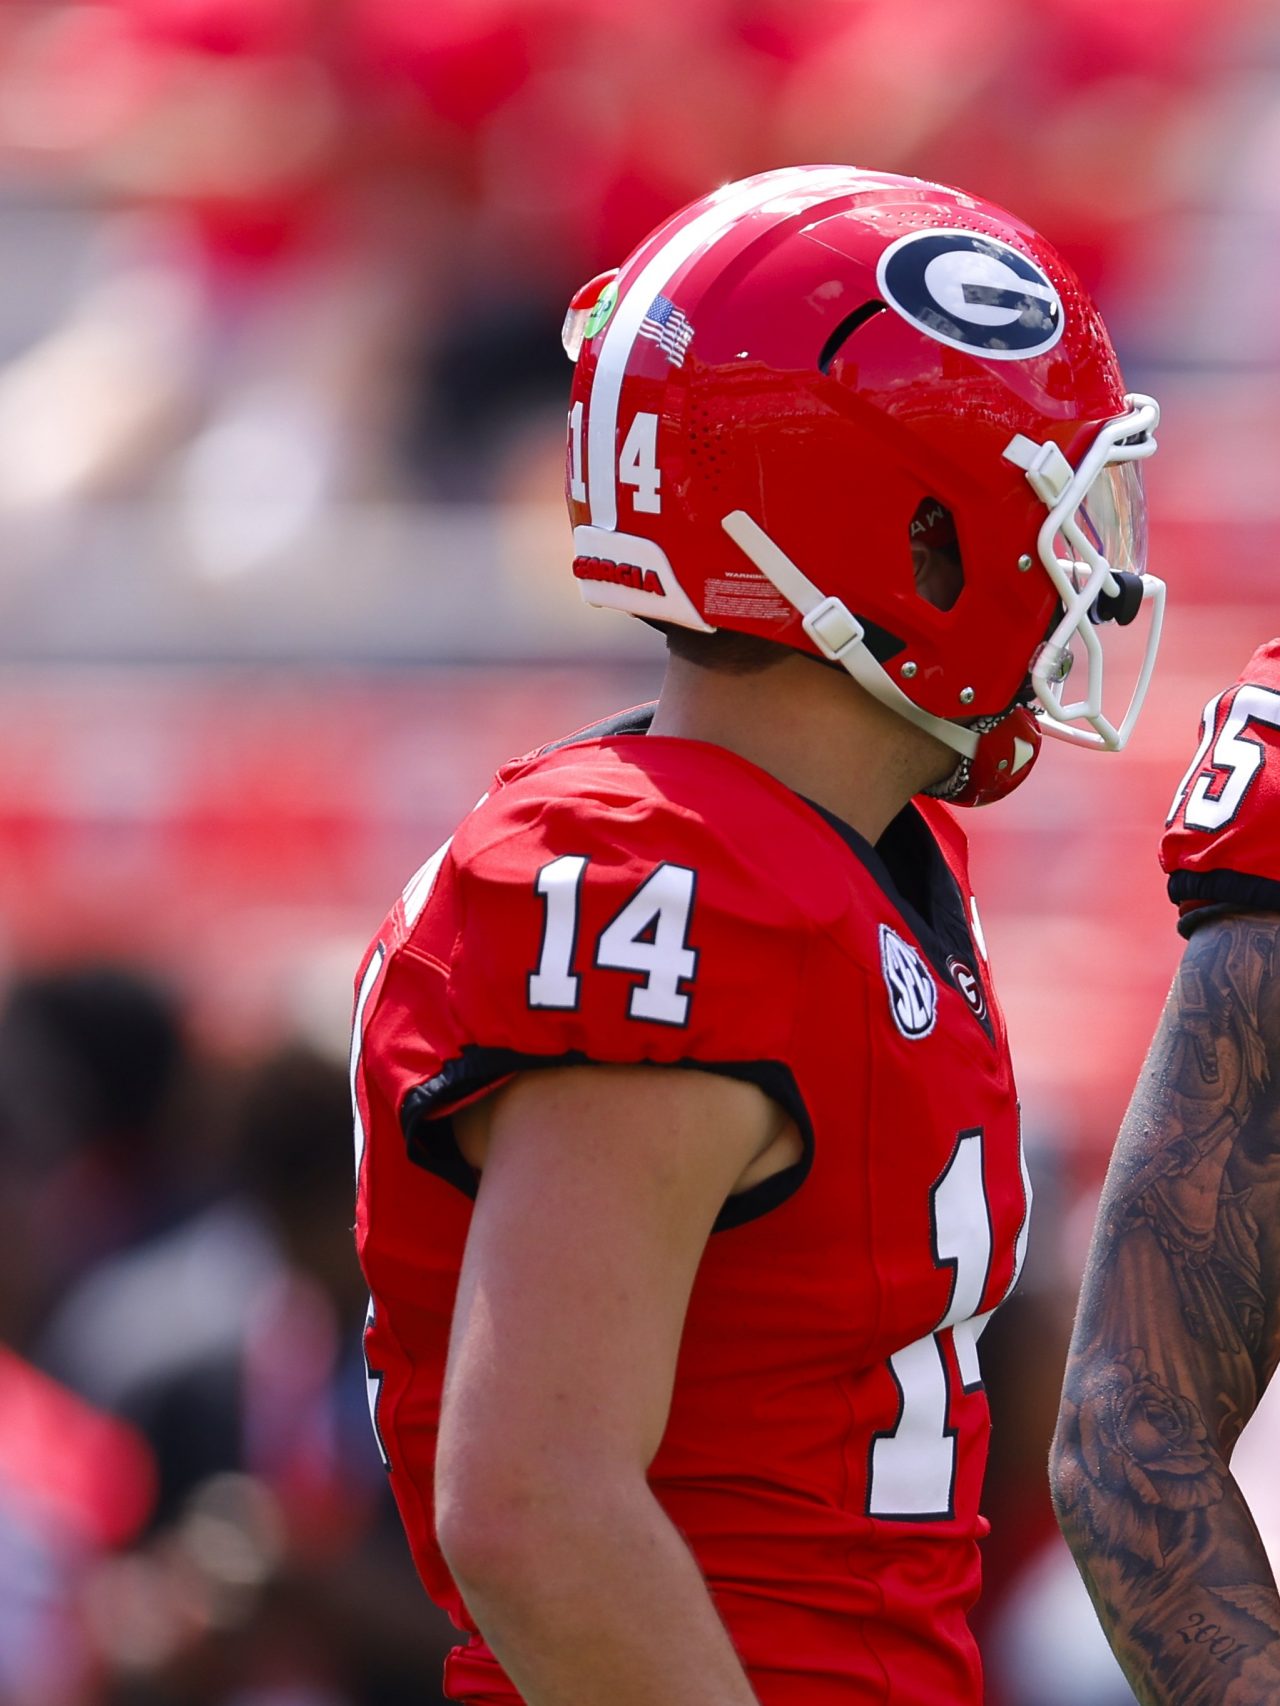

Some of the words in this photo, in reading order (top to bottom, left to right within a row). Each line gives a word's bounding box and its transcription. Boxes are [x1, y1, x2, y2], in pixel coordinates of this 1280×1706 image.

[725, 571, 769, 580] WARNIN
[527, 855, 701, 1030] 14
[1175, 1612, 1249, 1665] 2001
